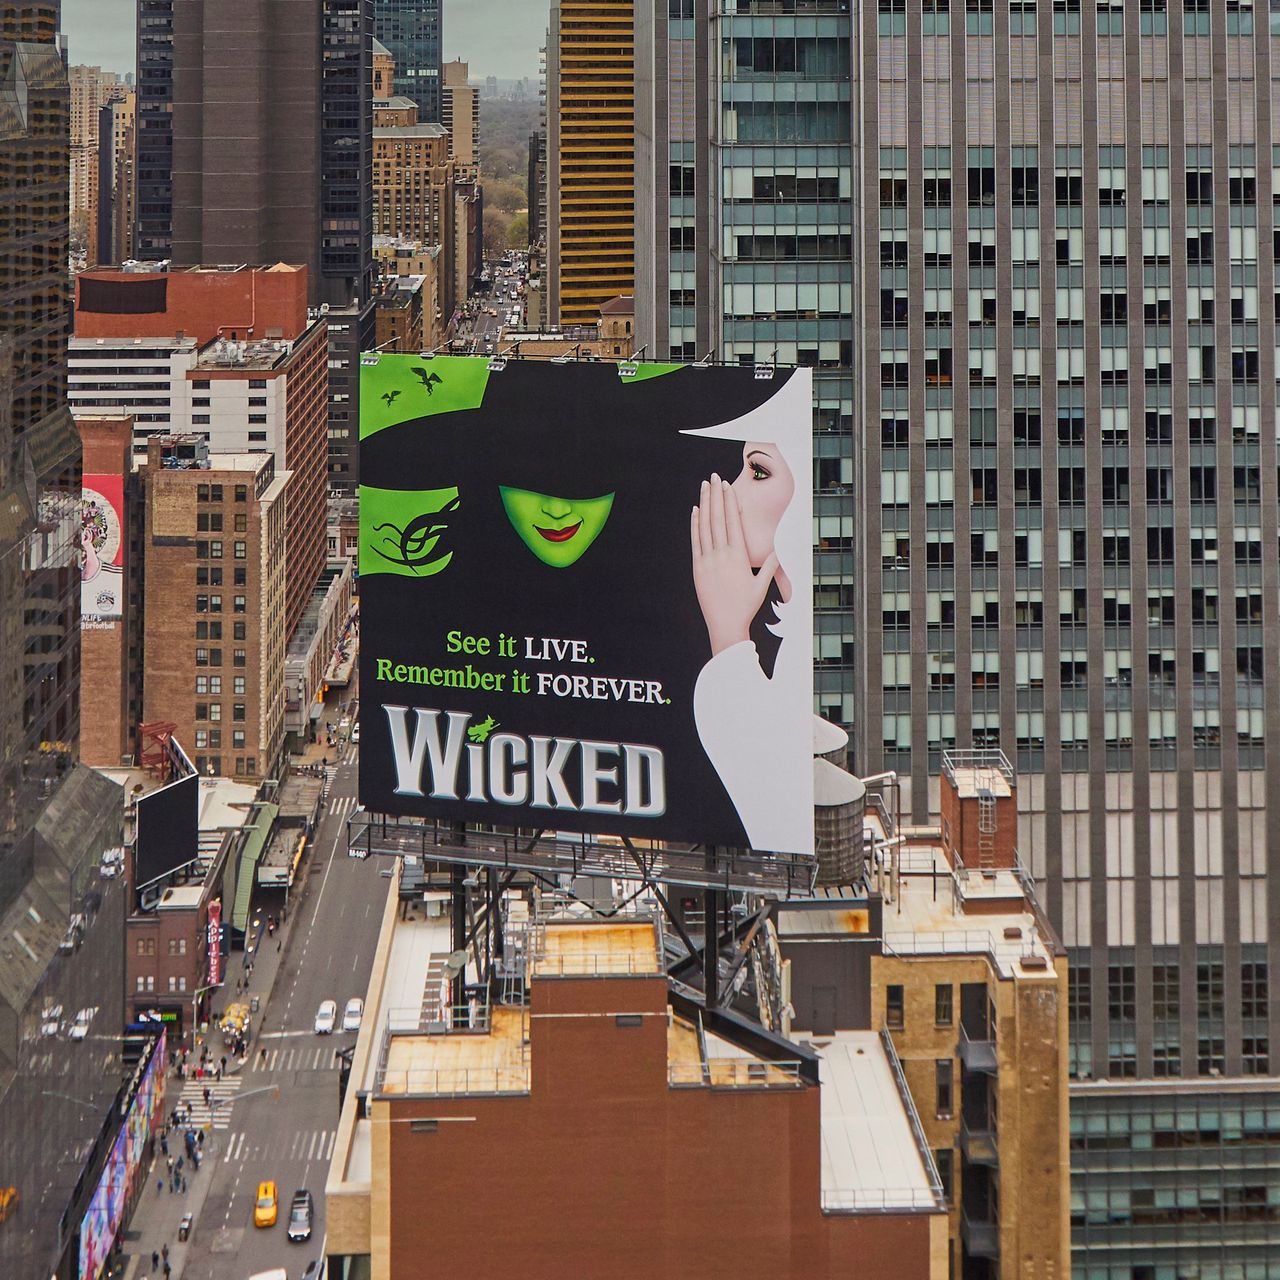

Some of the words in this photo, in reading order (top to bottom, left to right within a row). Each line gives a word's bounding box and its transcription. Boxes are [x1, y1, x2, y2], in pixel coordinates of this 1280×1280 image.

[446, 630, 491, 656] See
[498, 633, 518, 658] it
[524, 636, 596, 664] LIVE.
[376, 658, 506, 693] Remember
[511, 669, 531, 694] it
[536, 672, 672, 705] FOREVER.
